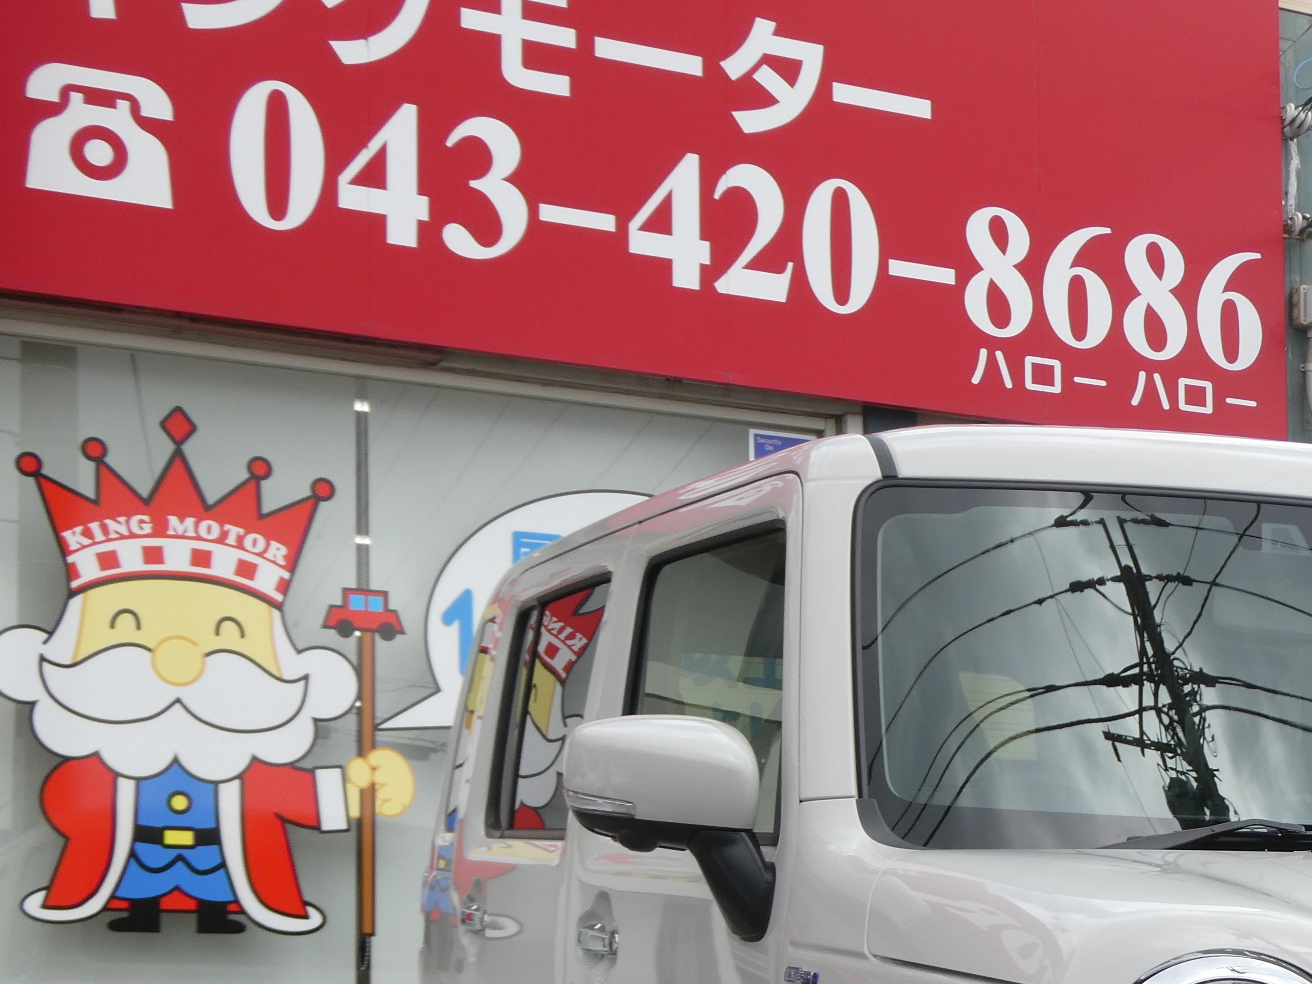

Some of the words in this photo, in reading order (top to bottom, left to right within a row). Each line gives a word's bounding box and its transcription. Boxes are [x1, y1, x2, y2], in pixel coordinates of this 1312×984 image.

[88, 0, 931, 134] モーター
[229, 80, 1262, 371] 043-420-8686
[971, 347, 1107, 394] ハロー
[1130, 370, 1258, 414] ハロー
[61, 515, 153, 551] KING
[166, 515, 289, 566] MOTOR
